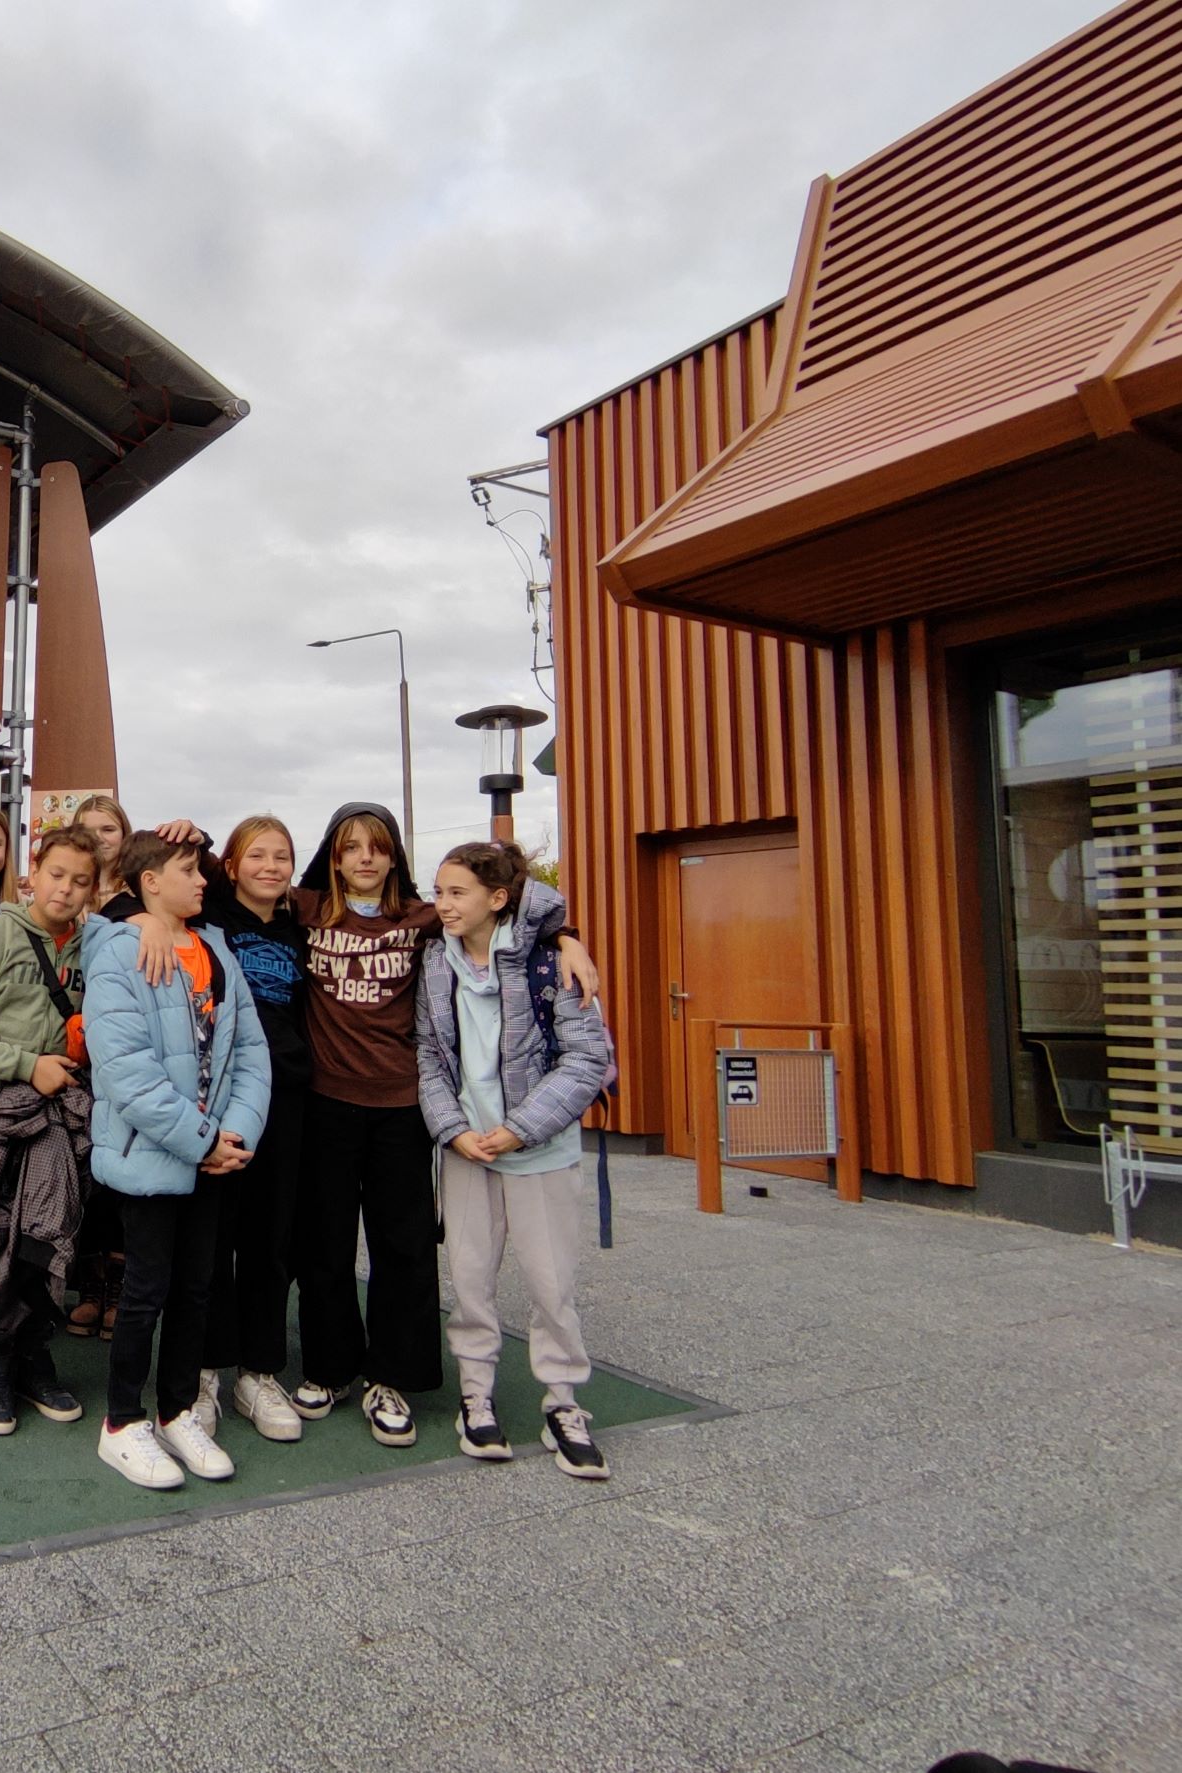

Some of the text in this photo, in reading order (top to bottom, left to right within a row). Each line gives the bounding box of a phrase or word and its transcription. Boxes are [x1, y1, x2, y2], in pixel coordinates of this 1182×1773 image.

[306, 949, 413, 979] NEW YORK
[336, 978, 380, 1003] 1982
